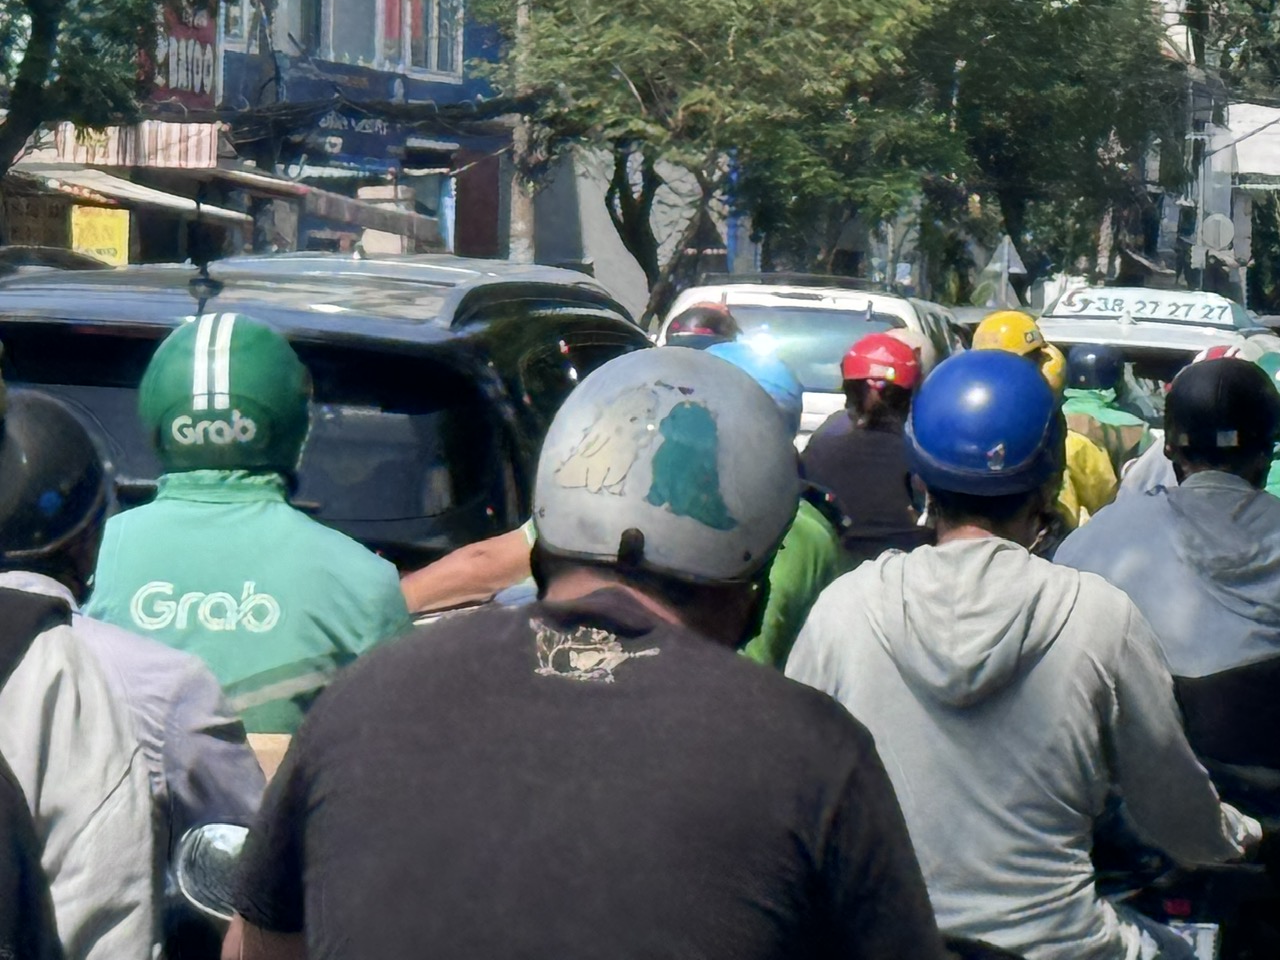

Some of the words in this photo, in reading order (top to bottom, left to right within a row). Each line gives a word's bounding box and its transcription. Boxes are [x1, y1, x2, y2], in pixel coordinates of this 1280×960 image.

[1135, 300, 1160, 314] 27
[1167, 302, 1195, 318] 27
[1201, 304, 1229, 320] 27
[171, 409, 257, 445] Grab
[130, 581, 281, 632] Grab
